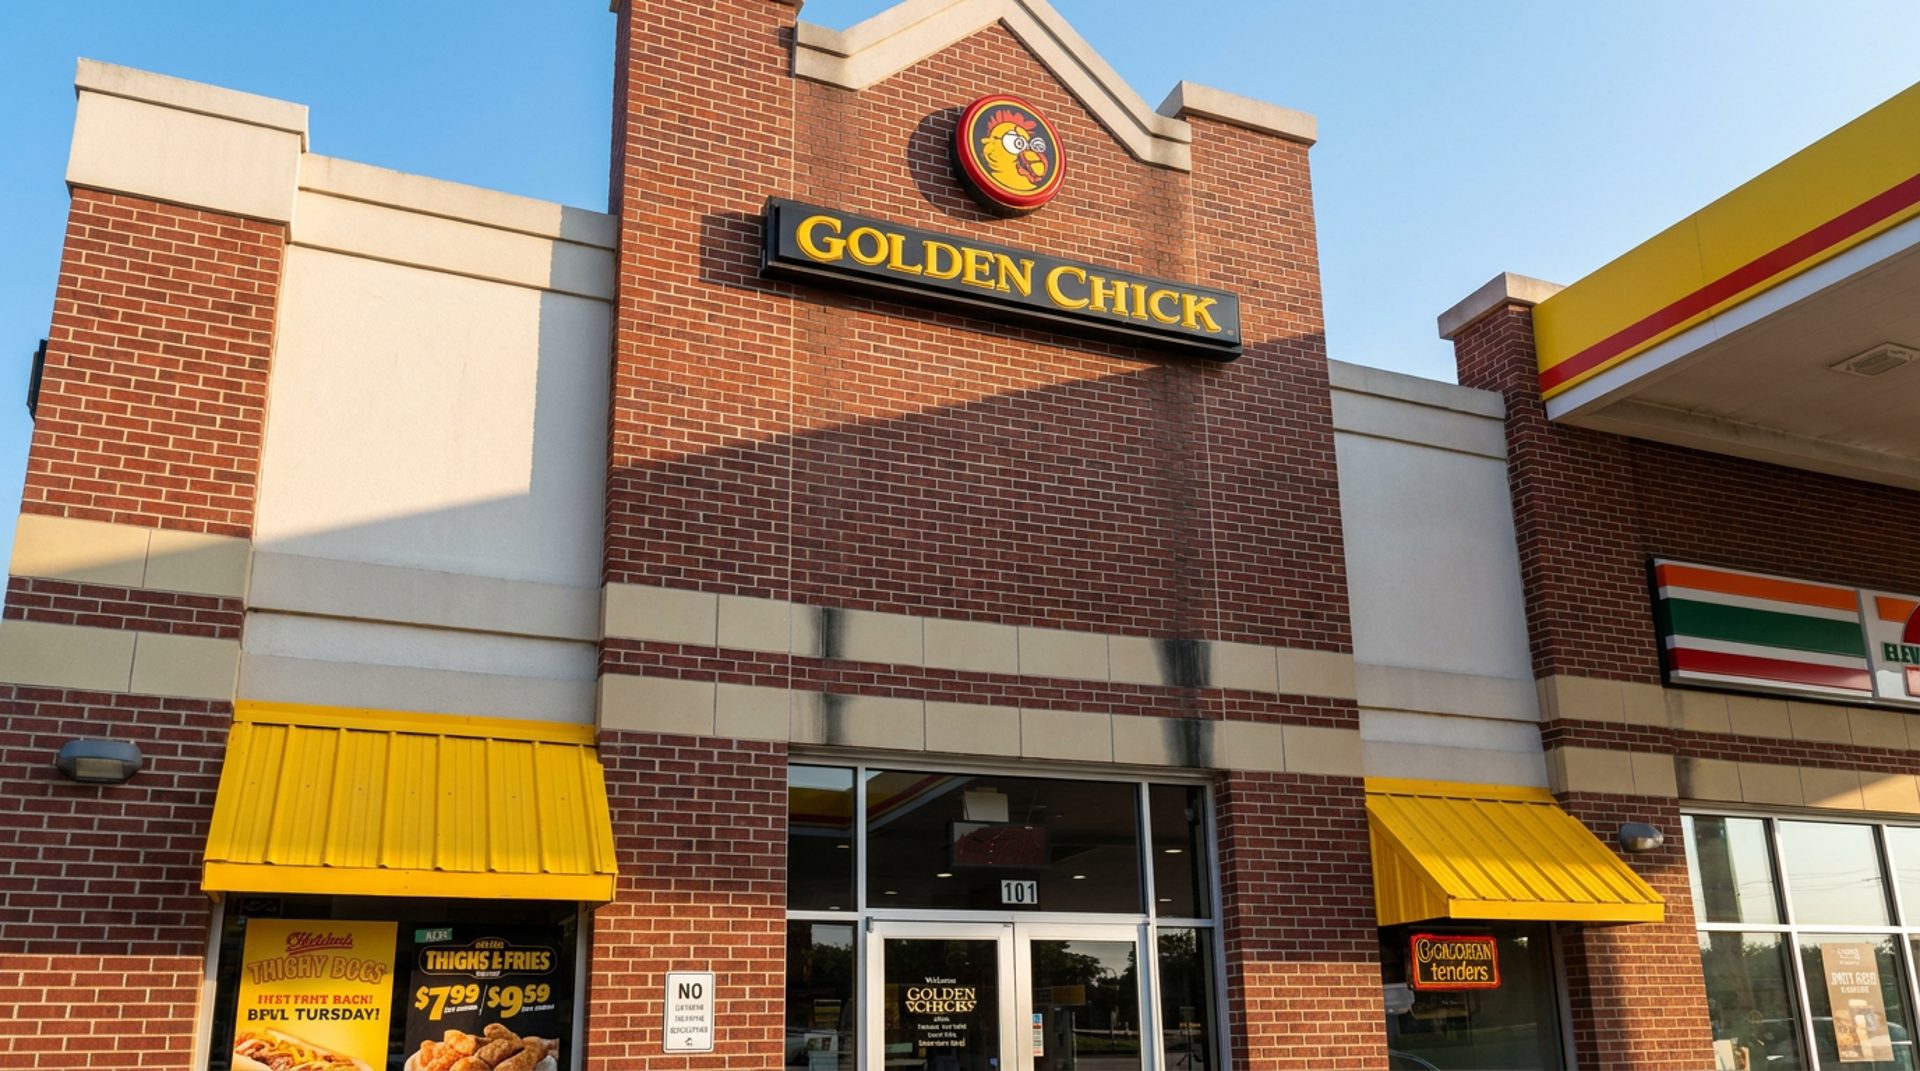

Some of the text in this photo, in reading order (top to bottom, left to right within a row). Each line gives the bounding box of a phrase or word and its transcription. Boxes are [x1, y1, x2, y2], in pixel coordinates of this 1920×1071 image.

[796, 214, 1222, 334] GOLDEN CHICK
[1004, 882, 1035, 903] 101
[503, 951, 551, 970] FRIES
[1430, 960, 1489, 981] tenders
[679, 982, 703, 1000] NO
[906, 986, 976, 1001] GOLDEN
